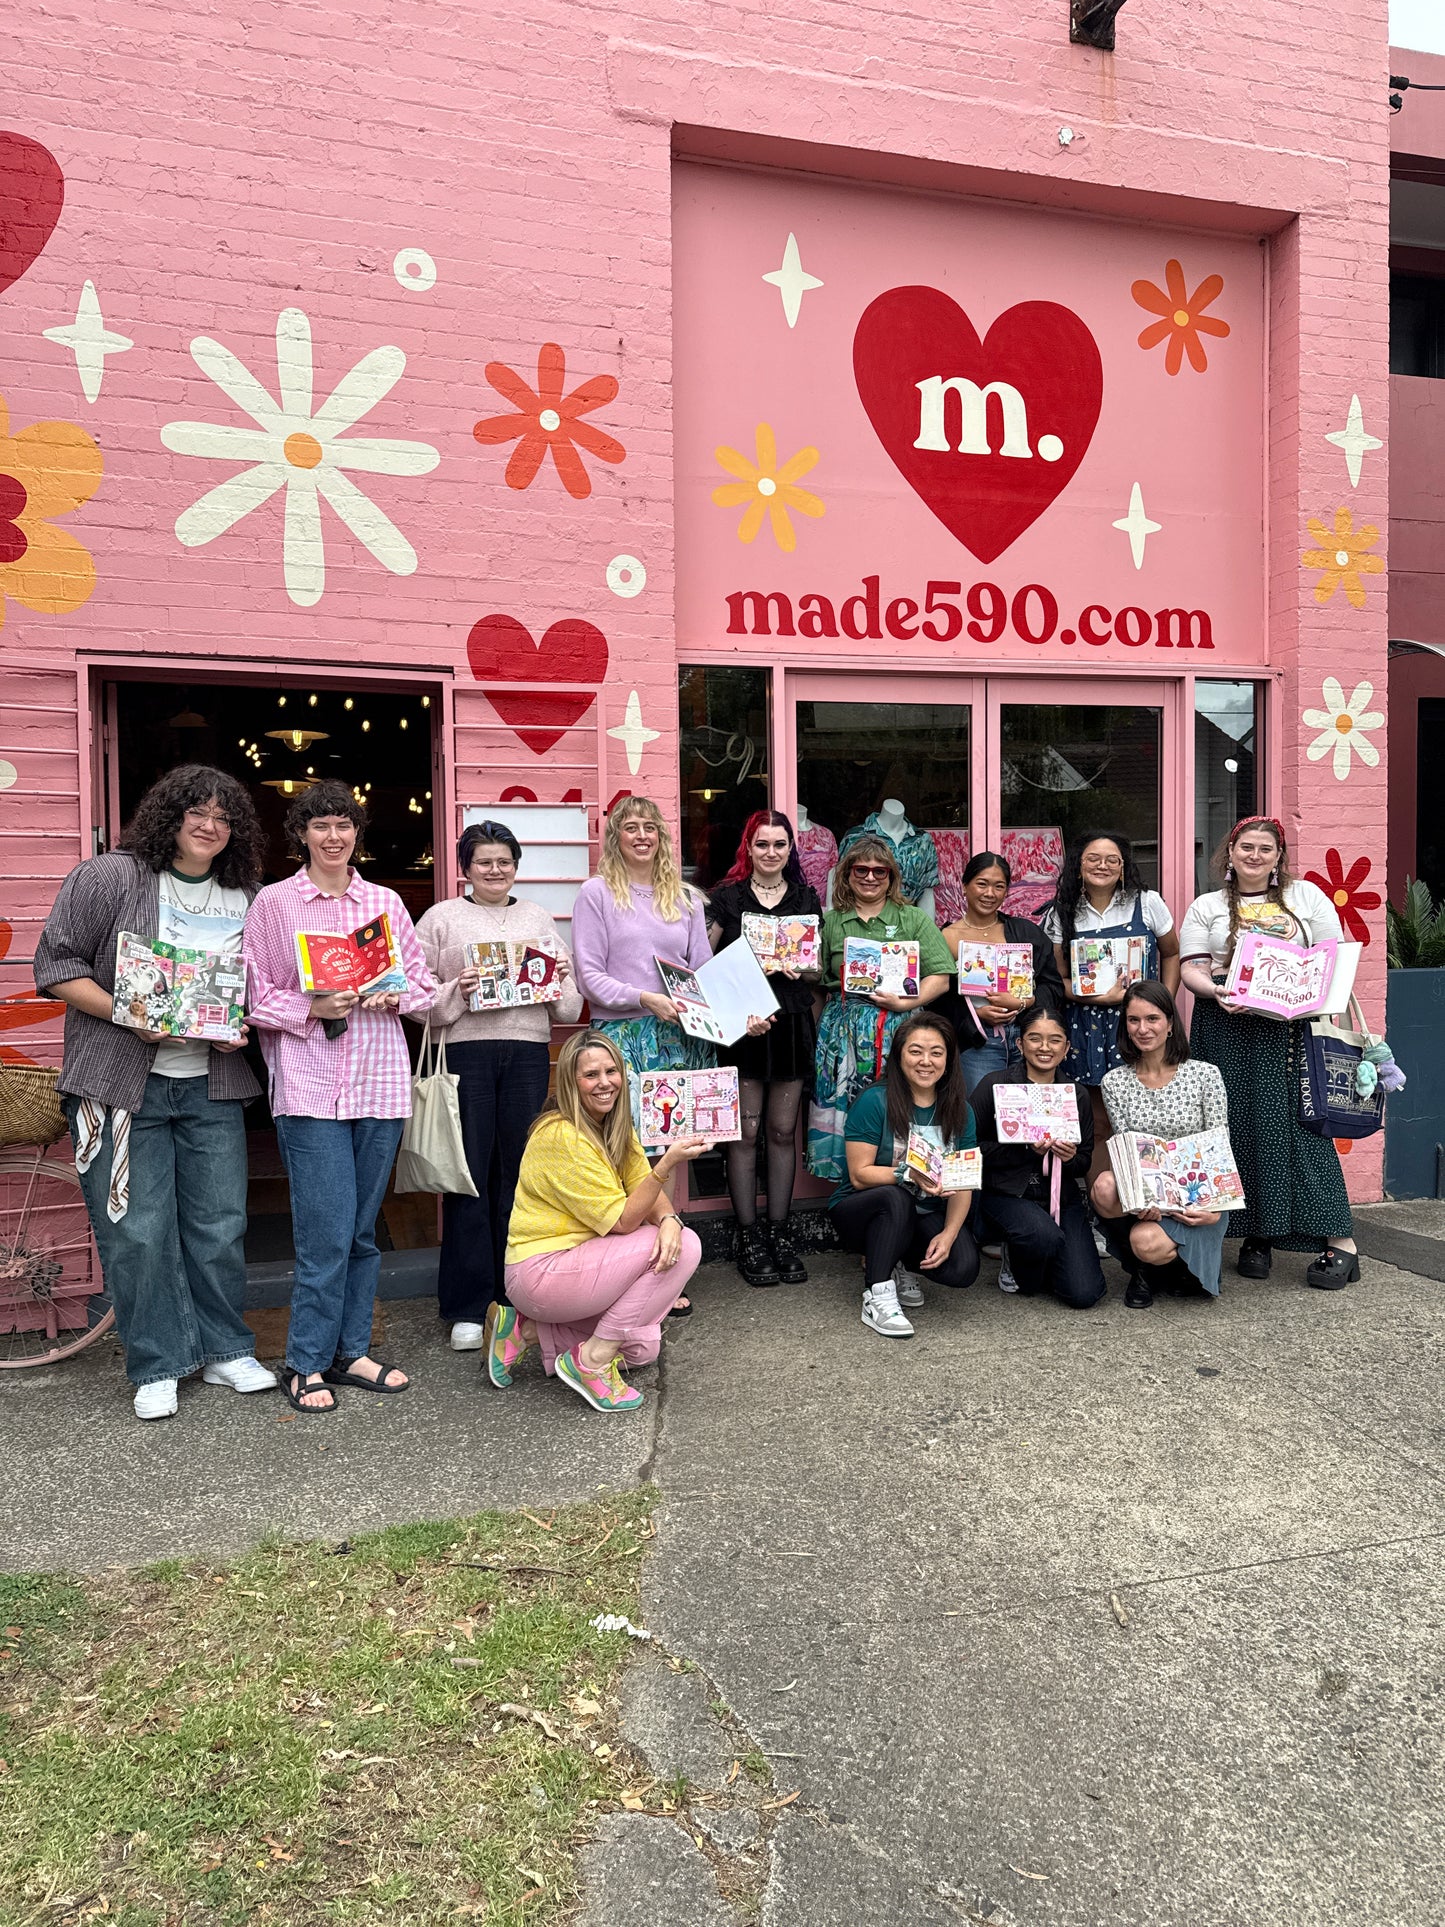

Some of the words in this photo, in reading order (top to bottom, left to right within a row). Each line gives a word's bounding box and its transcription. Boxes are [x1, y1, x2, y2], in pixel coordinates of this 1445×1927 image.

[913, 375, 1064, 462] m.
[725, 575, 1215, 649] made590.com
[160, 894, 178, 908] SKY
[185, 903, 244, 919] COUNTRY
[1261, 989, 1317, 1005] made590.
[1301, 1077, 1315, 1117] BOOKS
